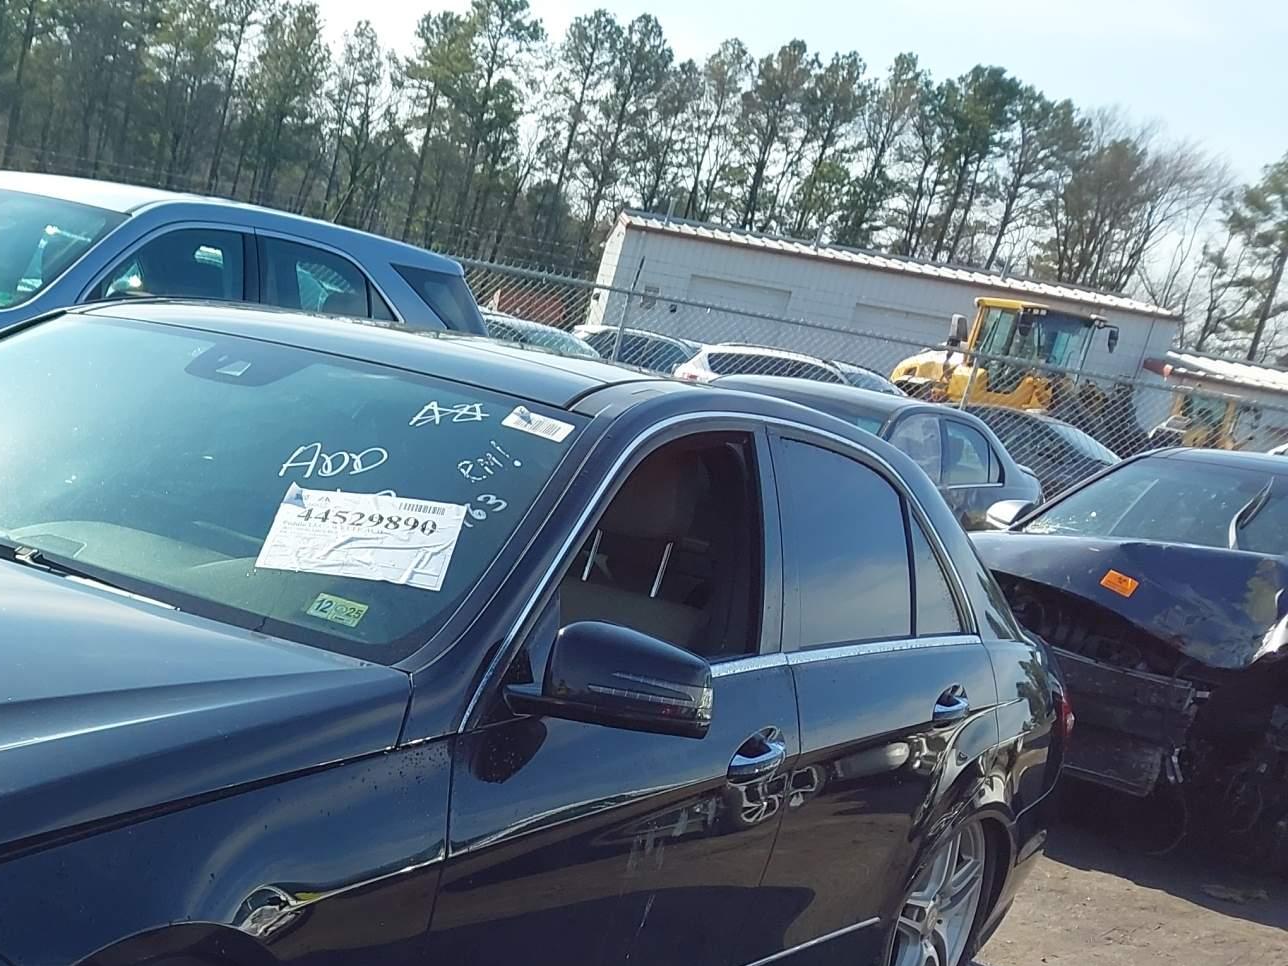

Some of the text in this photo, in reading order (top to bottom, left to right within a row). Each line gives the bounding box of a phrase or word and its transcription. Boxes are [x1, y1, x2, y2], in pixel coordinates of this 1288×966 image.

[279, 442, 389, 479] ADD
[297, 507, 438, 536] 44529890
[314, 599, 364, 619] 12 25
